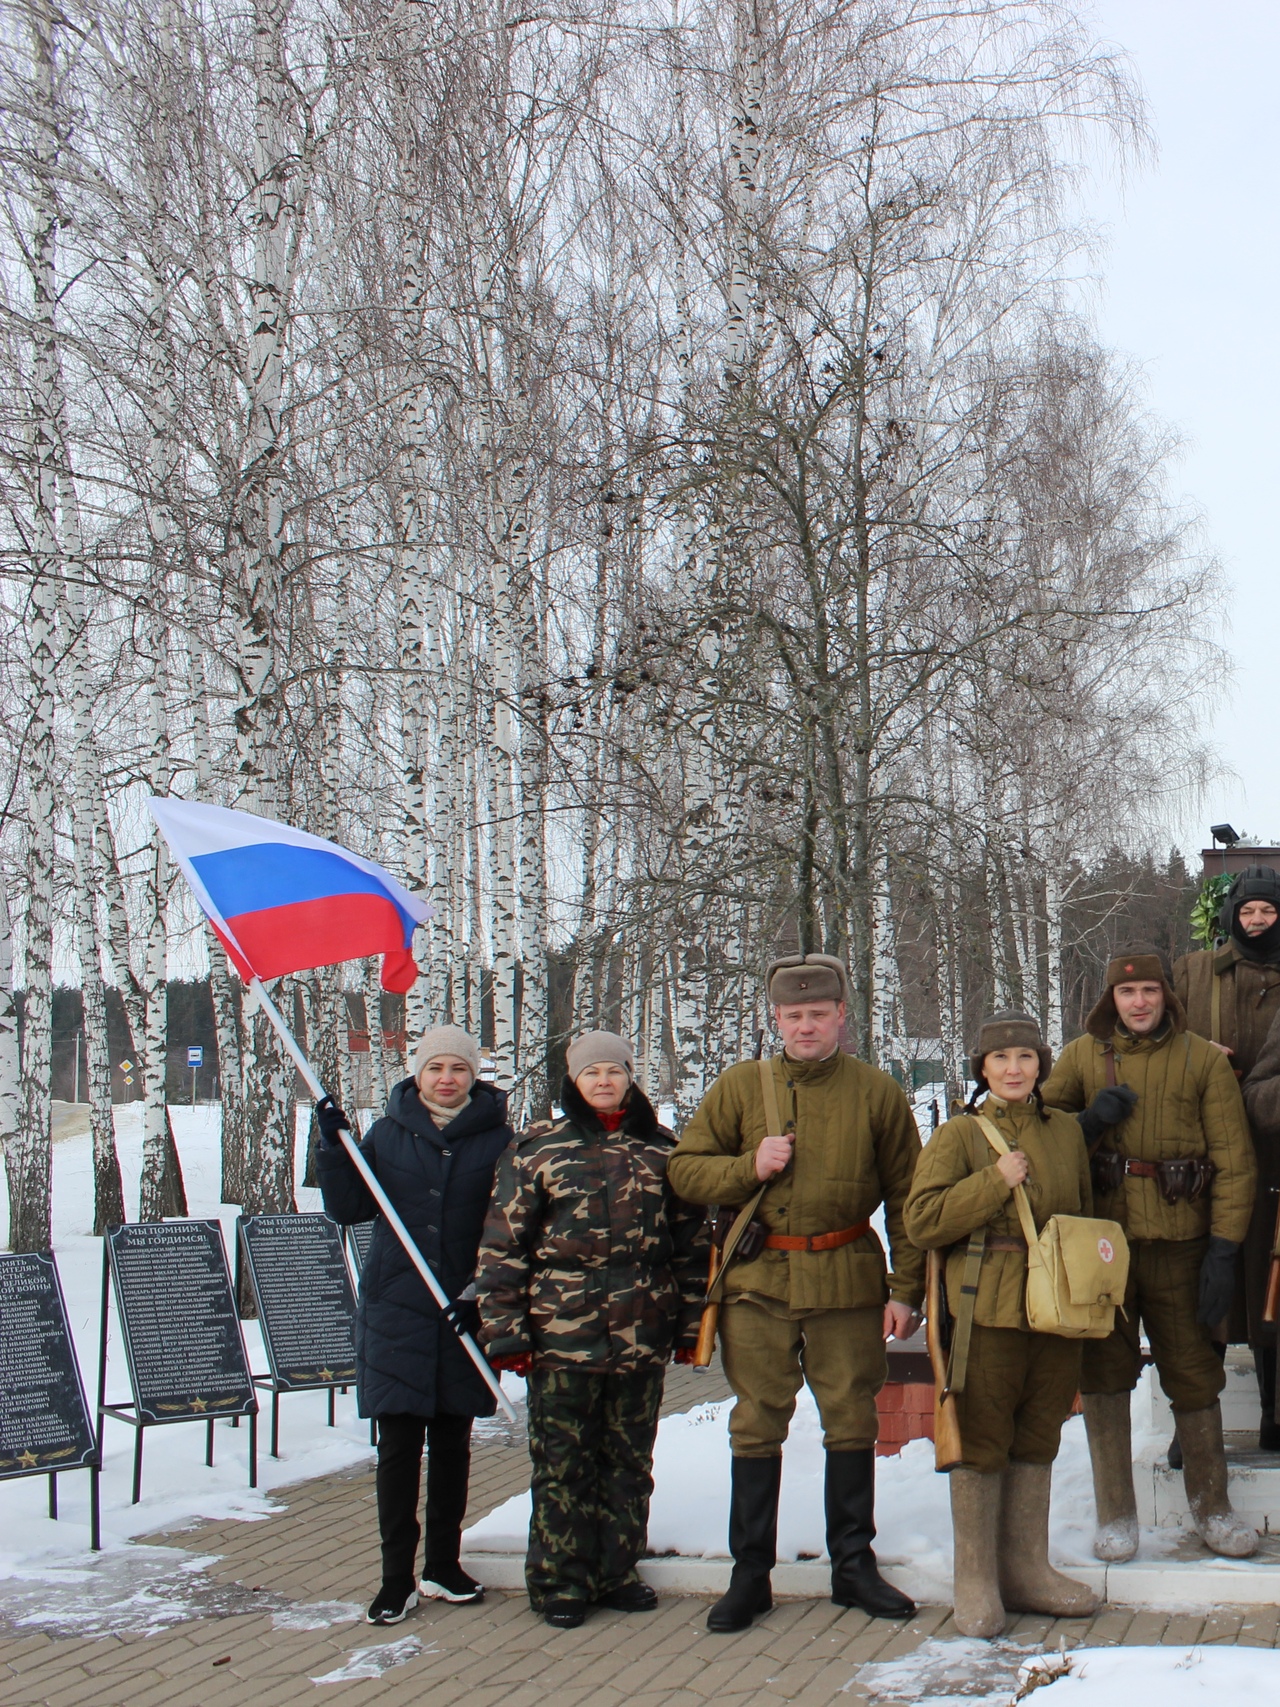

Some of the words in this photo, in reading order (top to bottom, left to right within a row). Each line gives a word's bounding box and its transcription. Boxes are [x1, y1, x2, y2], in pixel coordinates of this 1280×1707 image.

[148, 1224, 202, 1234] ПОМНИМ.
[147, 1233, 207, 1245] ГОРДИМСЯ!
[3, 1275, 46, 1286] ВЕЛИКОЙ
[16, 1282, 51, 1292] ВОЙНЫ
